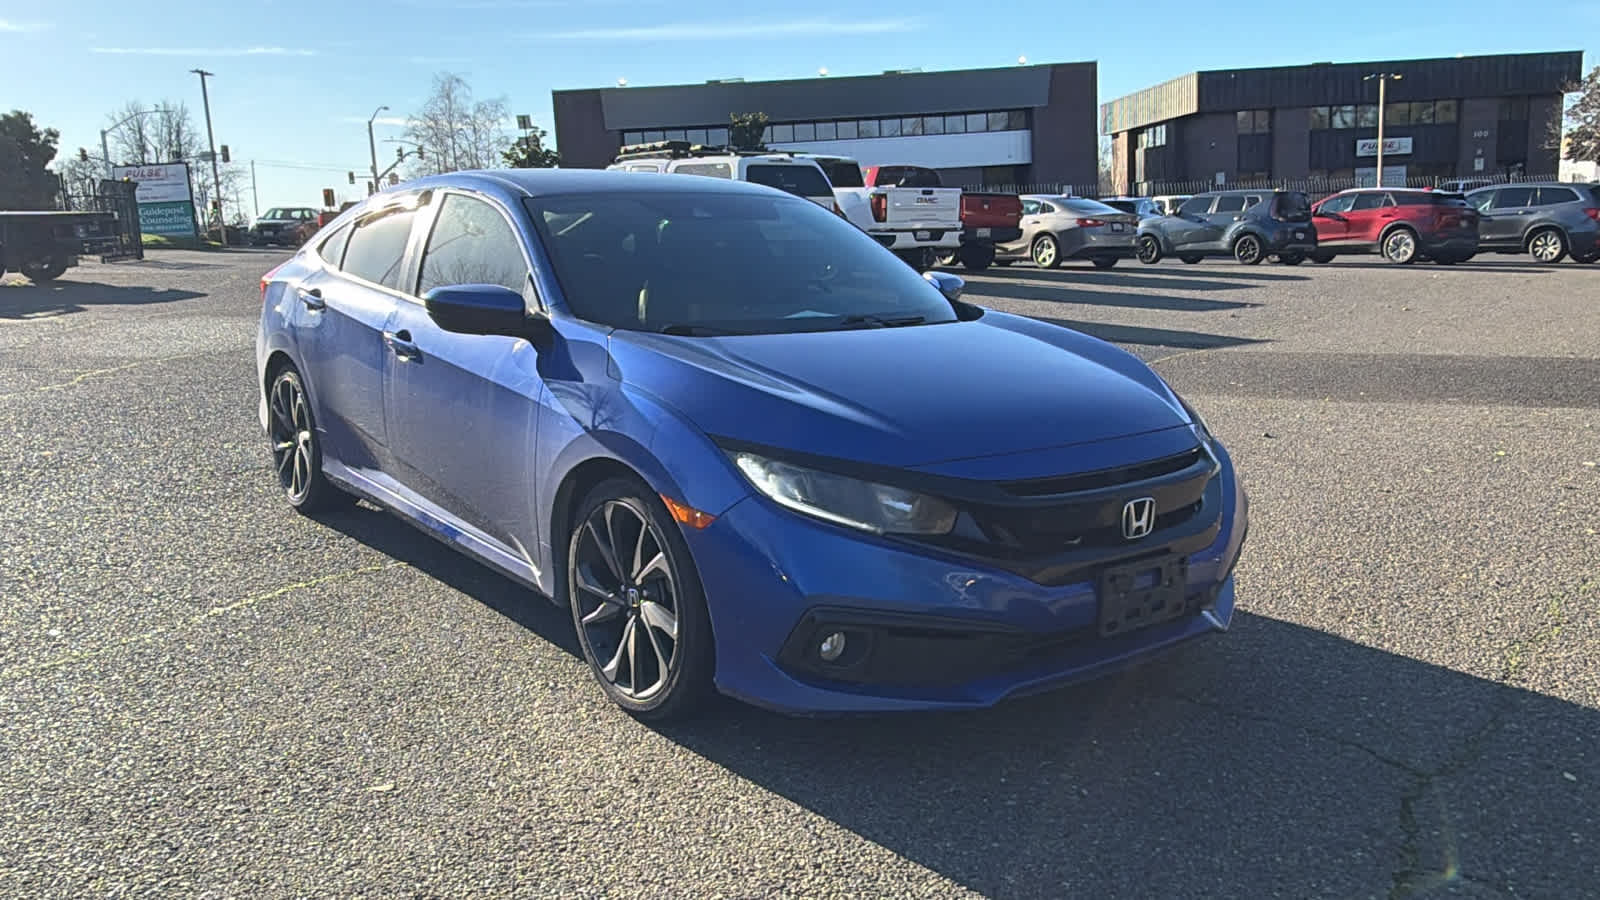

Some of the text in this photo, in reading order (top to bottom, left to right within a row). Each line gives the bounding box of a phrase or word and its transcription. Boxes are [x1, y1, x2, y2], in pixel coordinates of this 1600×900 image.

[125, 168, 162, 177] PULSE
[139, 206, 184, 217] Guidepost
[140, 215, 192, 226] Counseling
